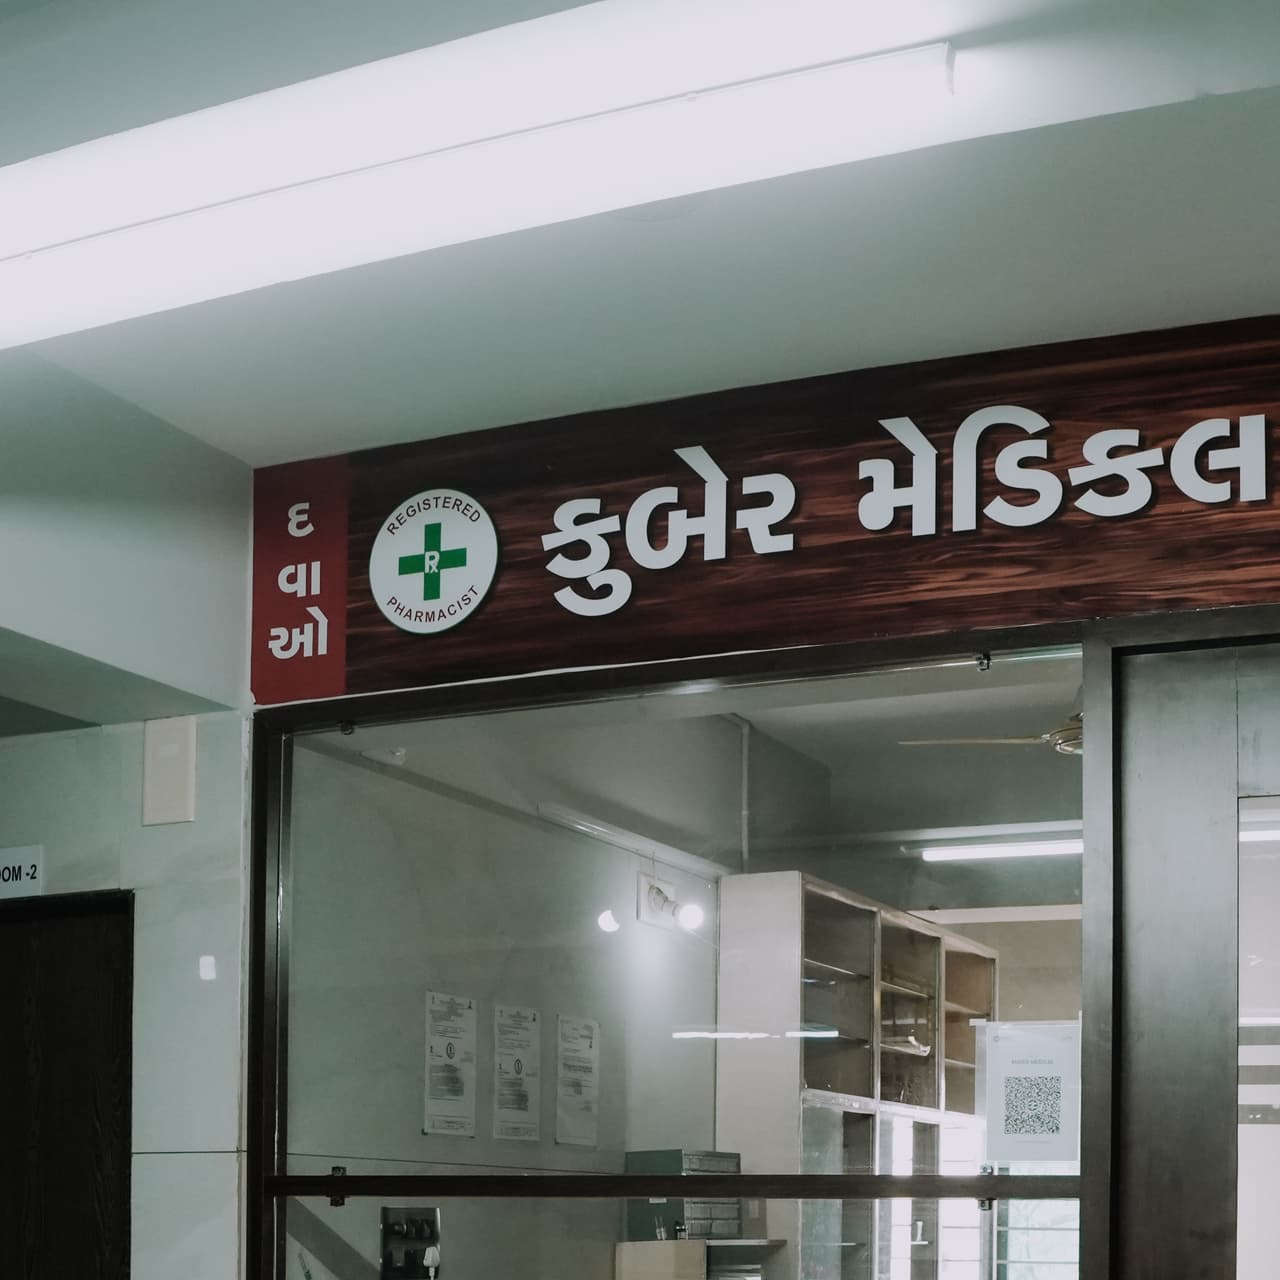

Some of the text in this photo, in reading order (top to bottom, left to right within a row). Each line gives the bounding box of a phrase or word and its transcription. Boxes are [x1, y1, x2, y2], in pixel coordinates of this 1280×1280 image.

[386, 496, 481, 535] REGISTERED
[540, 405, 1268, 618] કુબેર મેડિકલ
[386, 585, 479, 623] PHARMACIST
